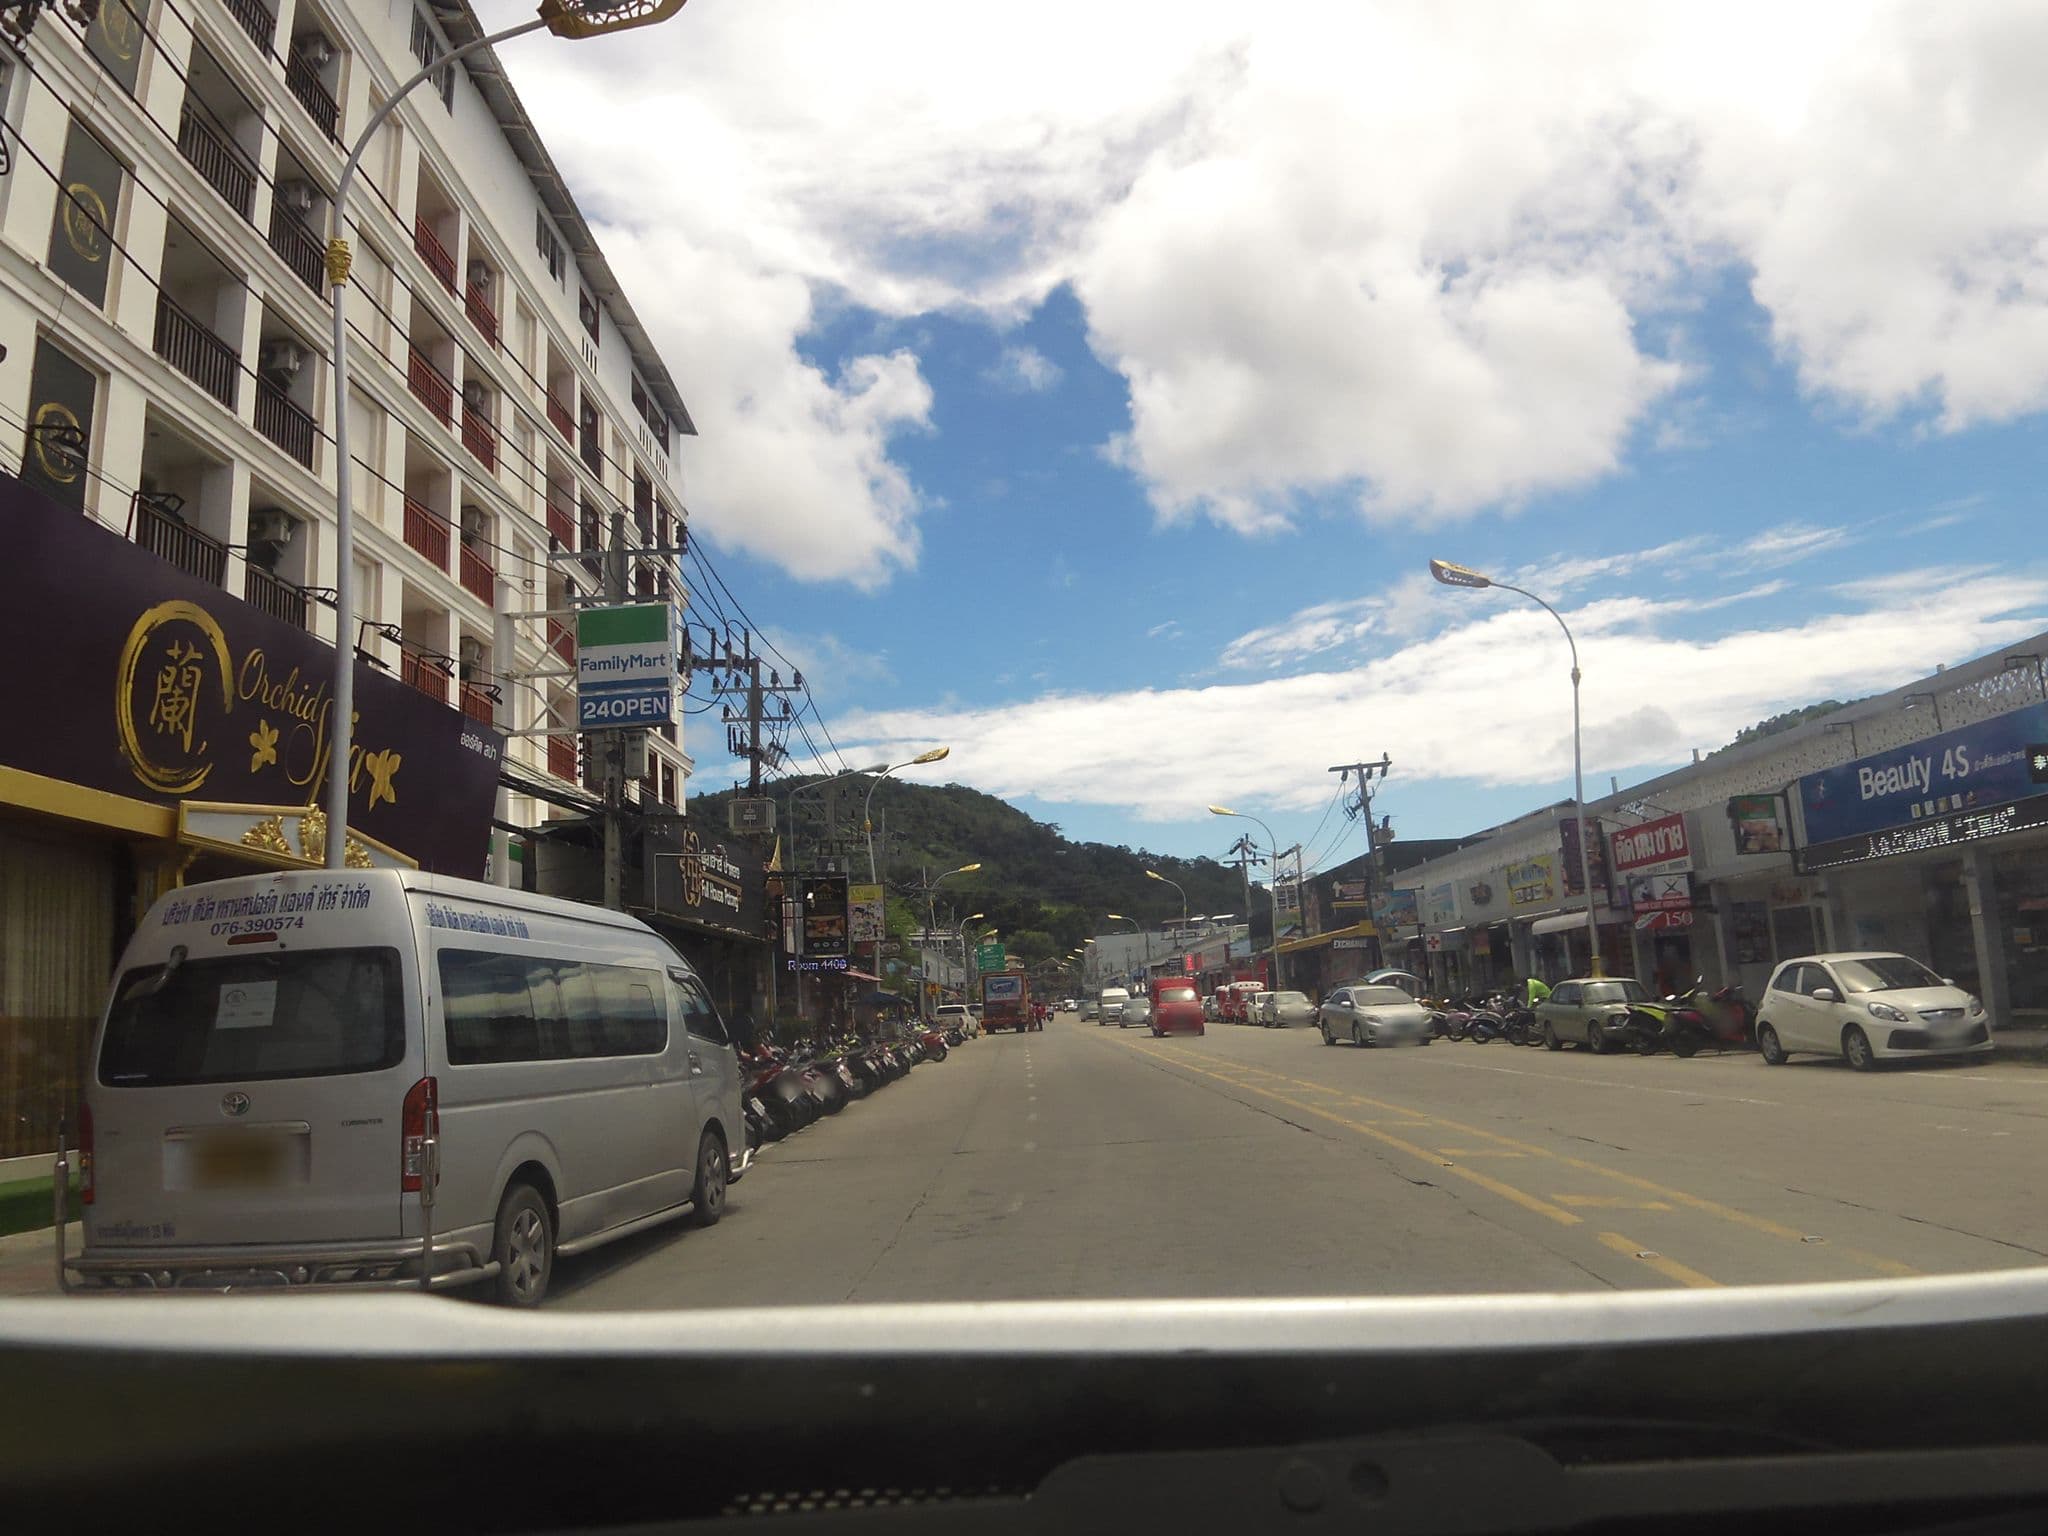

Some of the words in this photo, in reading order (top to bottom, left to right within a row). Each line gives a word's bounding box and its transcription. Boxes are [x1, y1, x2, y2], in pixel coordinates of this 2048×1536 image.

[580, 653, 666, 673] FamilyMart
[239, 648, 326, 722] Orchid
[1858, 755, 1932, 801] Beauty
[1941, 745, 1970, 780] 4S
[211, 916, 304, 936] 076-390574
